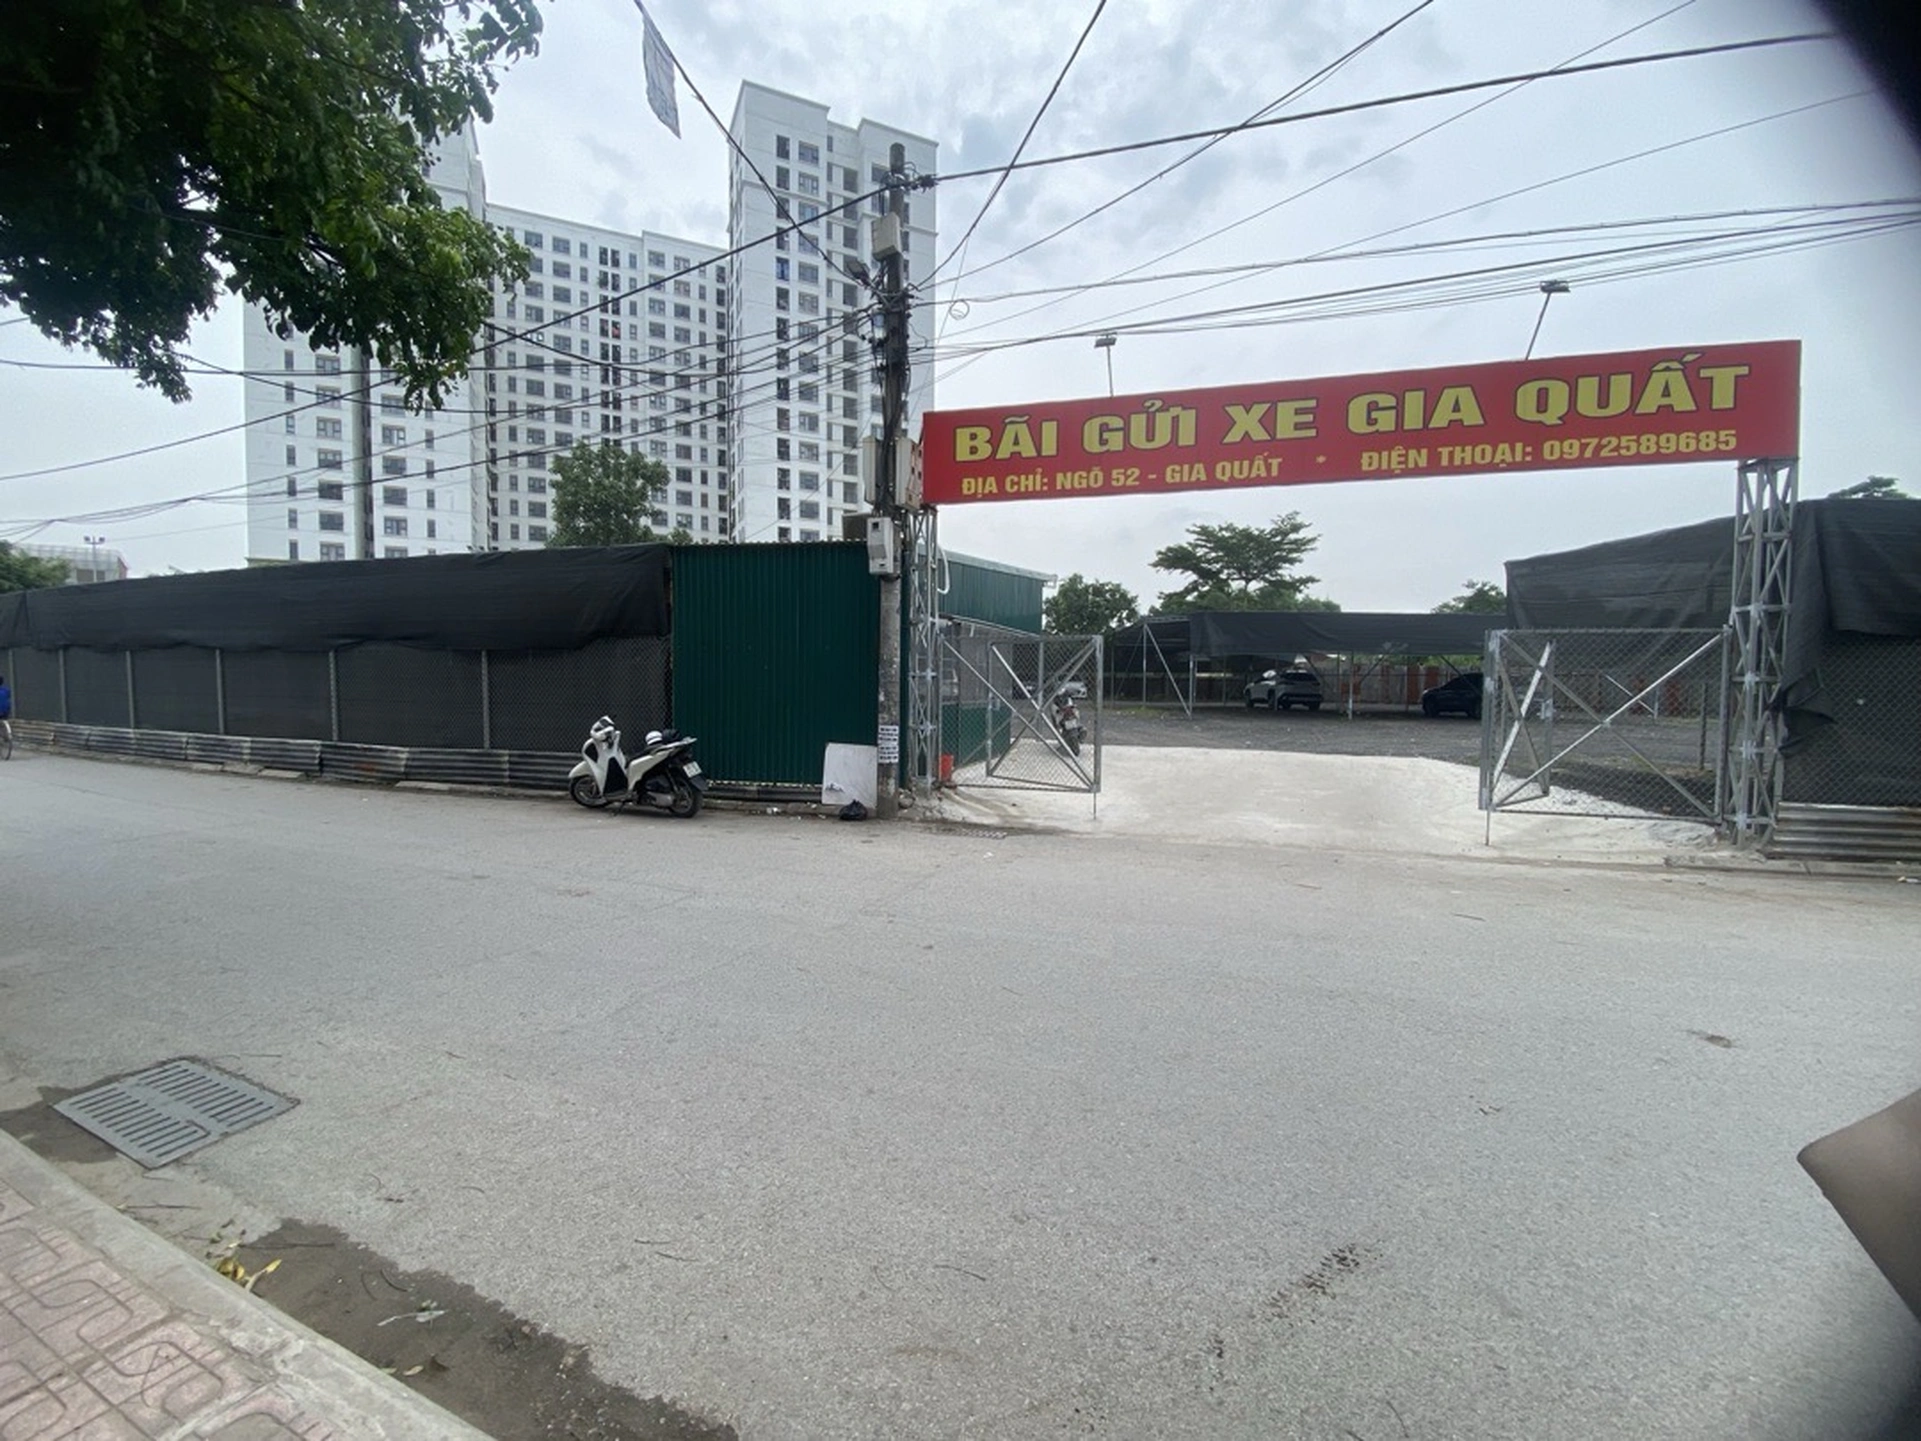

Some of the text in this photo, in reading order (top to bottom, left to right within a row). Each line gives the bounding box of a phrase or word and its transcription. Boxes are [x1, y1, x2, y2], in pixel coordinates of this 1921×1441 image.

[955, 353, 1749, 462] BÃI GỬI XE GIA QUẤT
[962, 476, 998, 498] ĐỊA
[1005, 467, 1048, 493] CHỈ:
[1111, 468, 1141, 487] 52
[1165, 463, 1207, 484] GIA
[1215, 451, 1283, 480] QUẤT
[1361, 445, 1428, 474] ĐIỆN
[1438, 442, 1532, 467] THOẠI:
[1543, 430, 1737, 460] 0972589685
